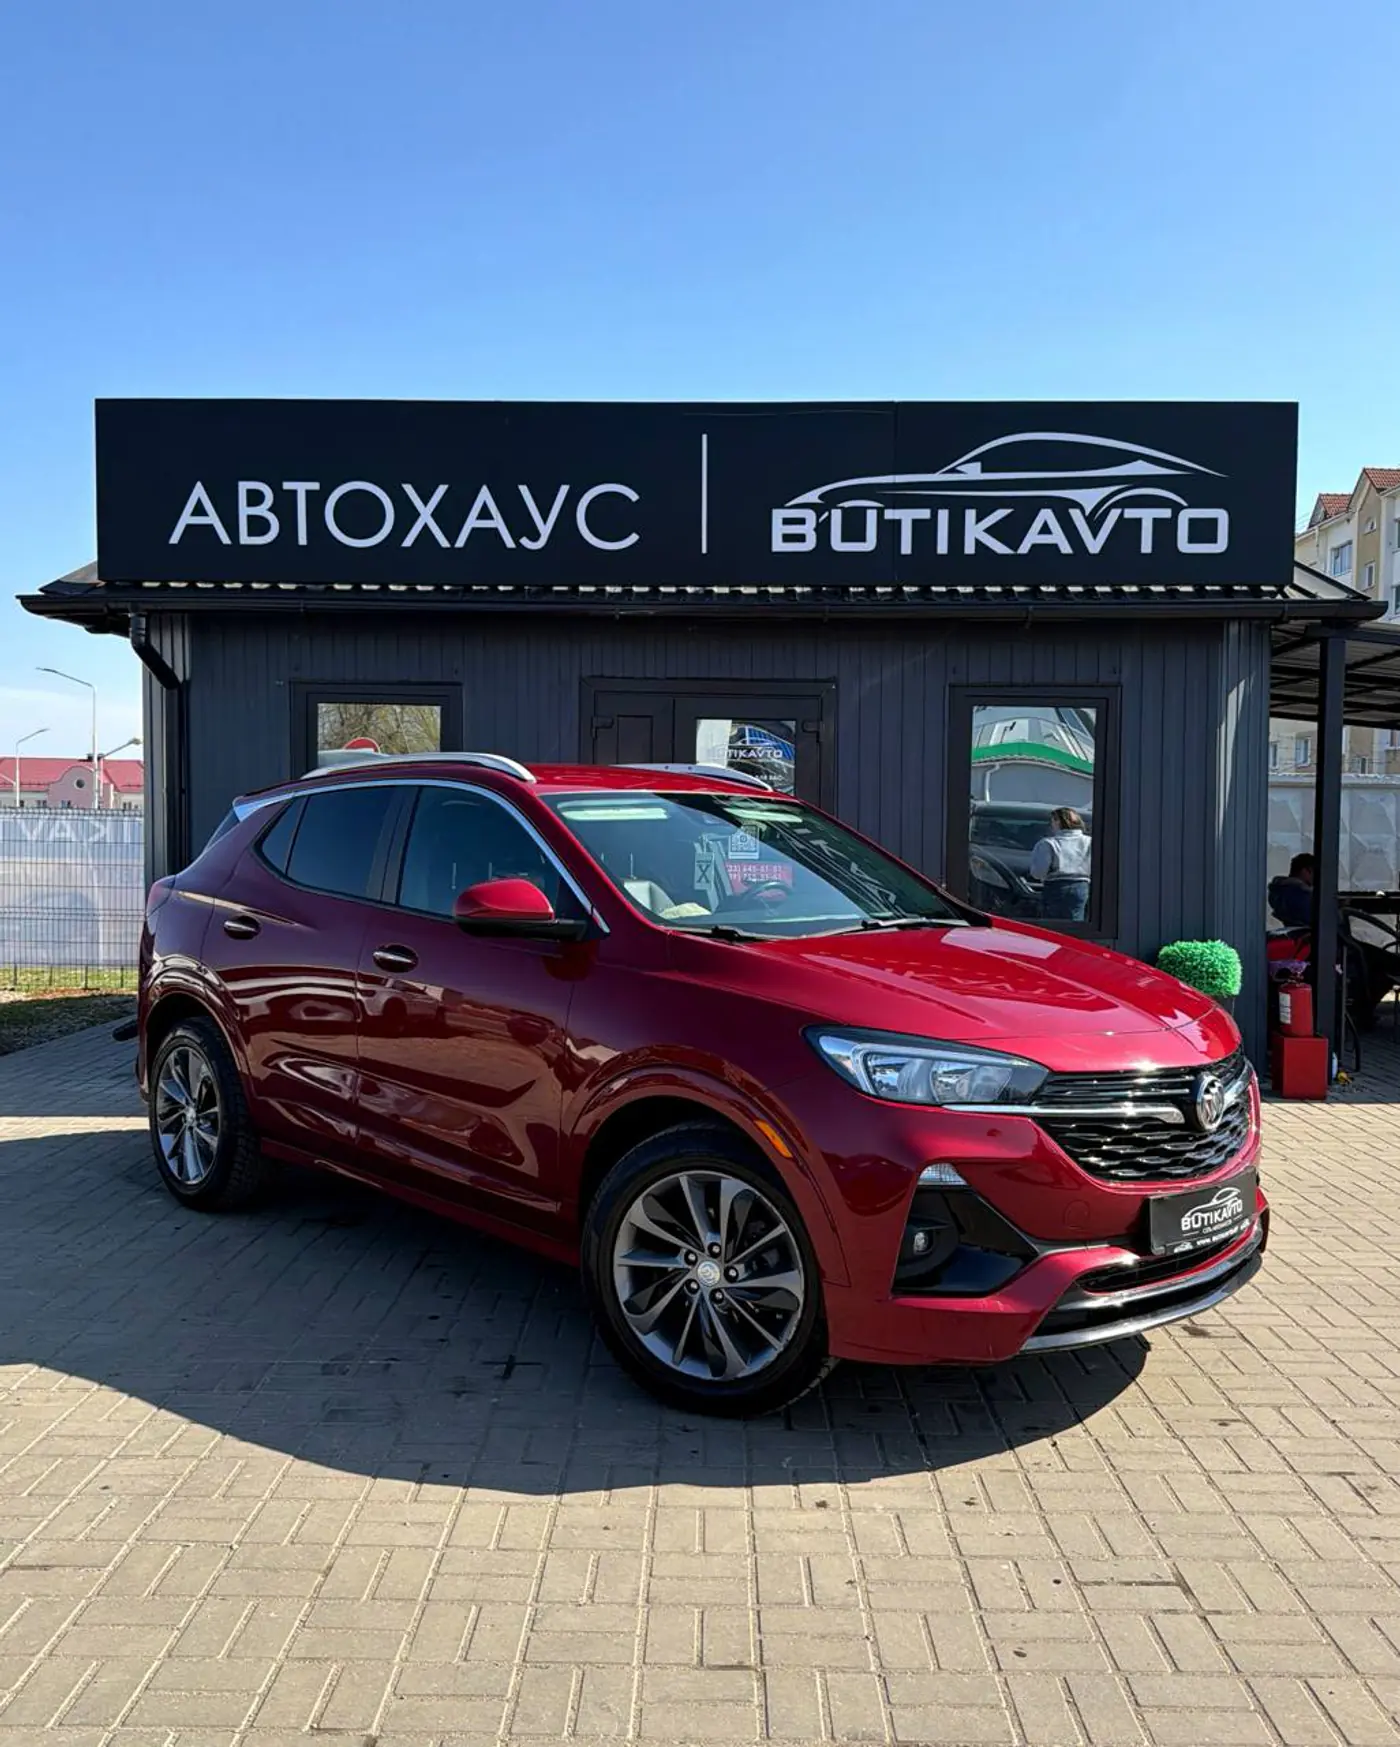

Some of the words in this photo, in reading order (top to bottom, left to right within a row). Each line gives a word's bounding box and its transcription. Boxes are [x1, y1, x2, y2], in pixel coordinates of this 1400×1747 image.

[168, 480, 640, 550] АВТОХАУС
[771, 508, 1230, 555] BUTIKAVTO
[710, 749, 784, 759] TIKAVTO
[1181, 1198, 1243, 1231] BUTIKAVTO
